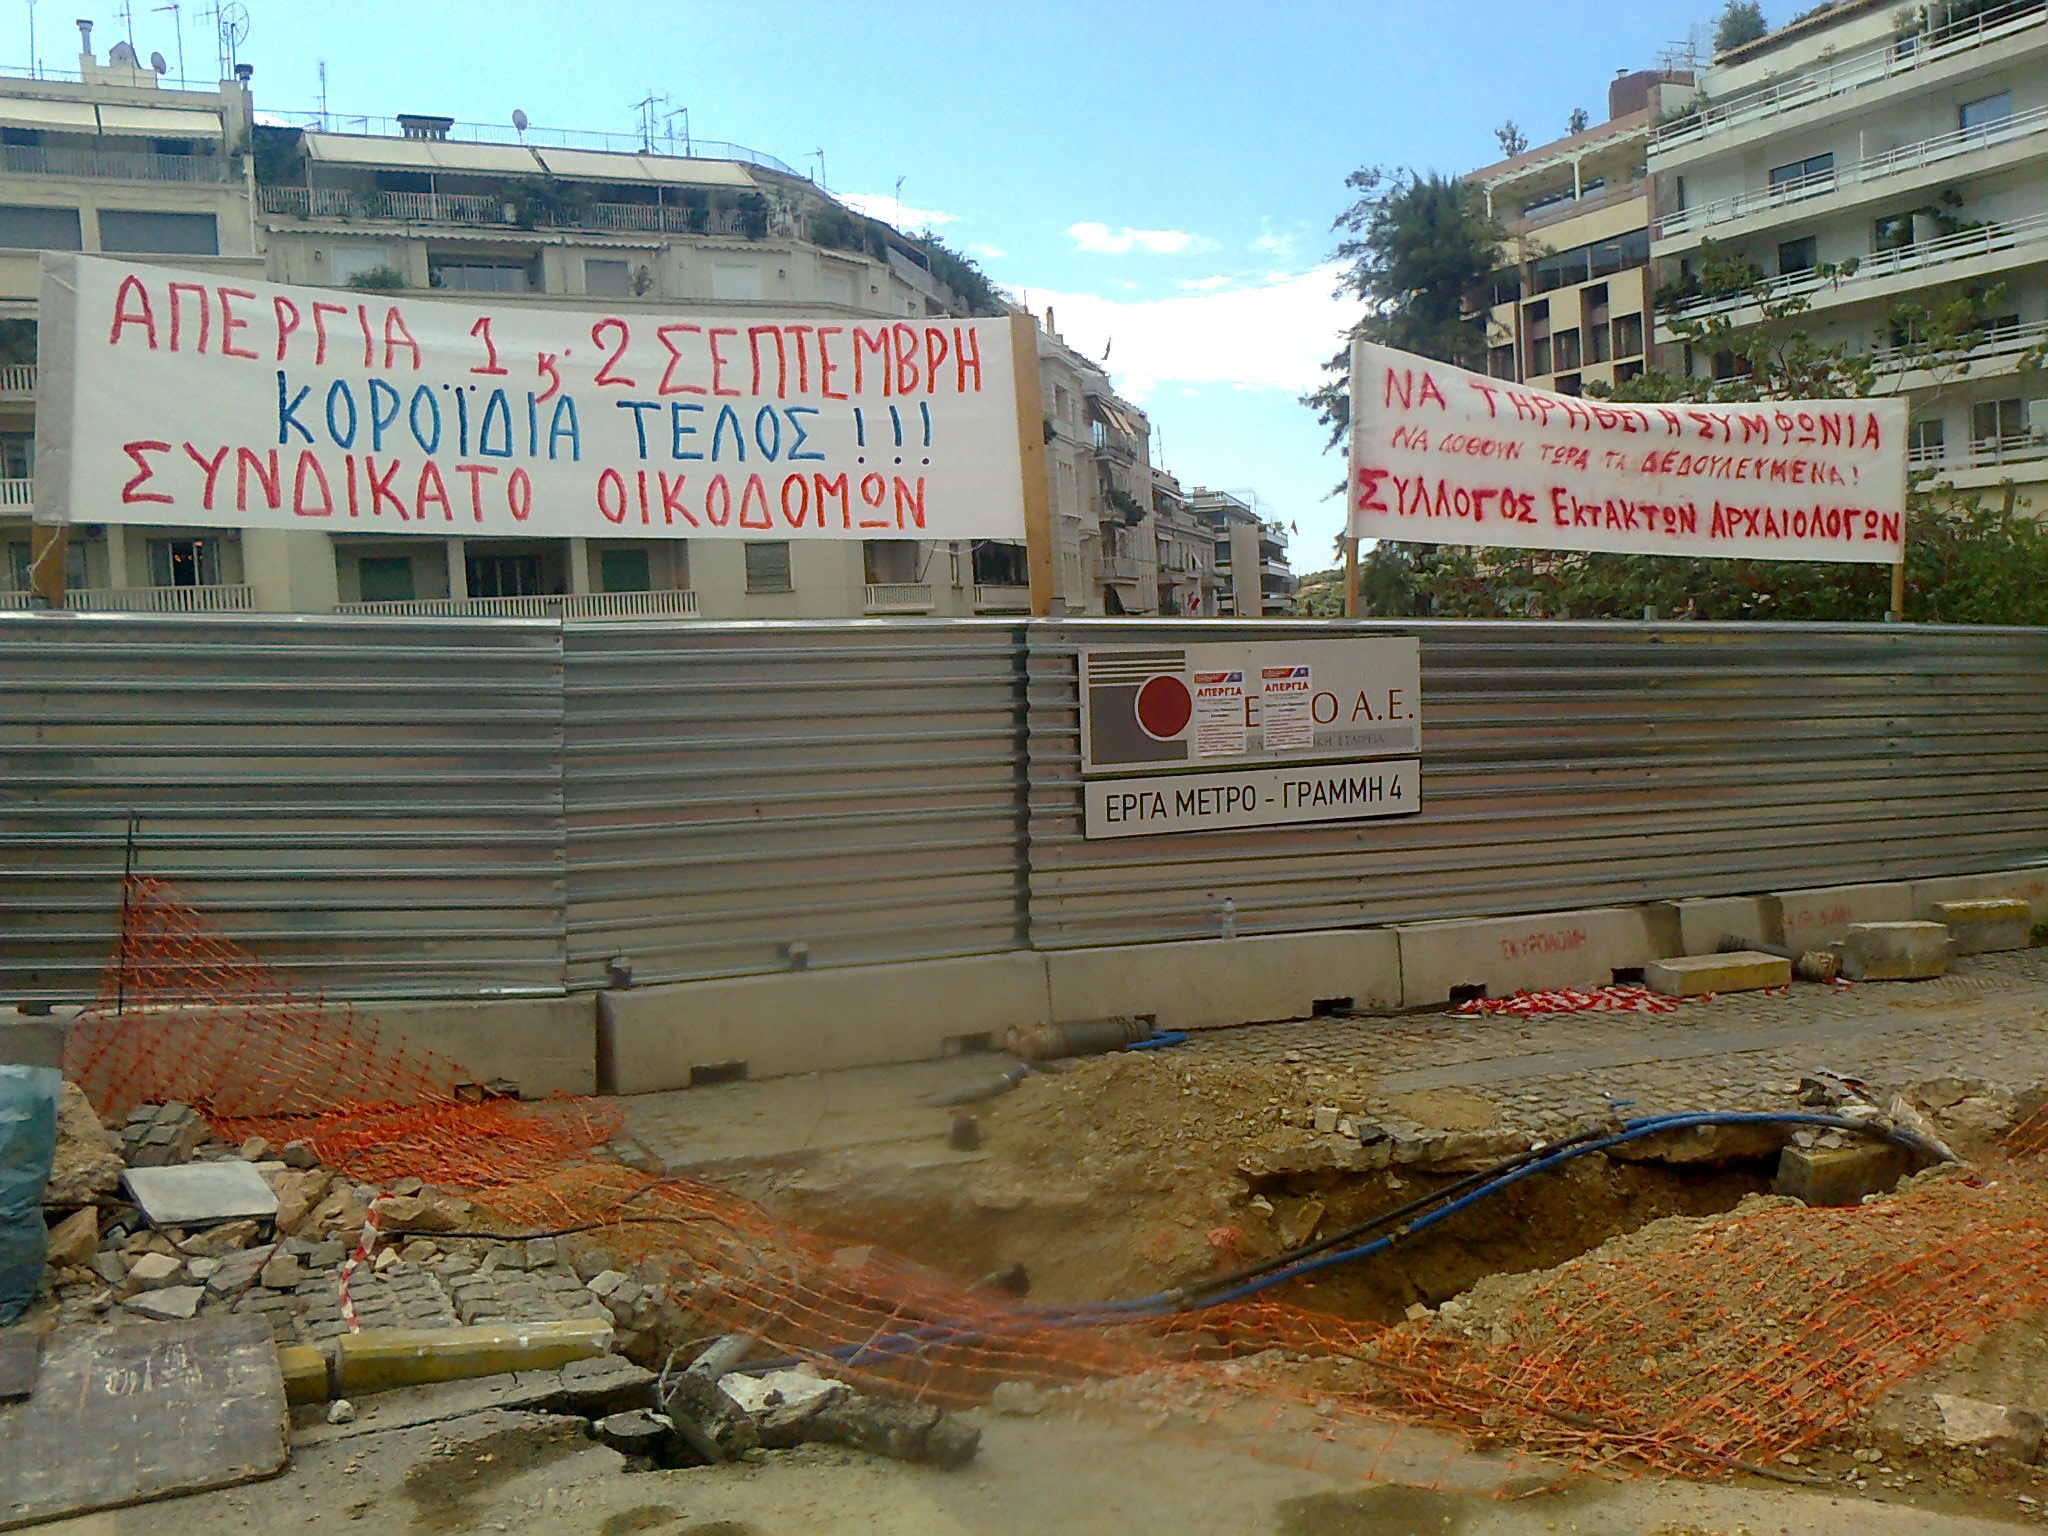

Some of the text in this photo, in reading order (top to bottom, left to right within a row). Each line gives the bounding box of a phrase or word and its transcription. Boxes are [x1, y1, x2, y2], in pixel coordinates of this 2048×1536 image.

[109, 275, 421, 370] ΑΠΕΡΓΙΑ
[470, 317, 508, 375] 1
[592, 317, 636, 388] 2
[656, 322, 981, 400] ΣΕΠΤΕΜΒΡΗ
[276, 370, 581, 461] ΚΟΡΟΪΔΙΑ
[1384, 366, 1446, 411] ΝΑ
[1657, 408, 1681, 438] Η
[1687, 410, 1881, 450] ΣΥΜΦΩΝΙΑ
[122, 440, 926, 530] ΣΥΝΔΙΚΑΤΟ ΟΙΚΟΔΟΜΩΝ
[1391, 424, 1428, 453] ΝΑ
[1540, 444, 1591, 471] ΤΩΡΑ
[1605, 449, 1626, 472] ΤΑ
[1358, 467, 1538, 524] ΣΥΛΛΟΓΟΣ
[1710, 500, 1900, 543] ΑΡΧΑΙΟΛΟΓΩΝ
[1196, 686, 1243, 698] ΑΠΕΡΓΙΑ
[1264, 681, 1309, 692] ΑΠΕΡΓΙΑ
[1106, 790, 1167, 823] ΕΡΓΑ
[1176, 784, 1257, 818] ΜΕΤΡΟ
[1283, 775, 1383, 809] ΓΡΑΜΜΗ
[1390, 774, 1402, 800] 4
